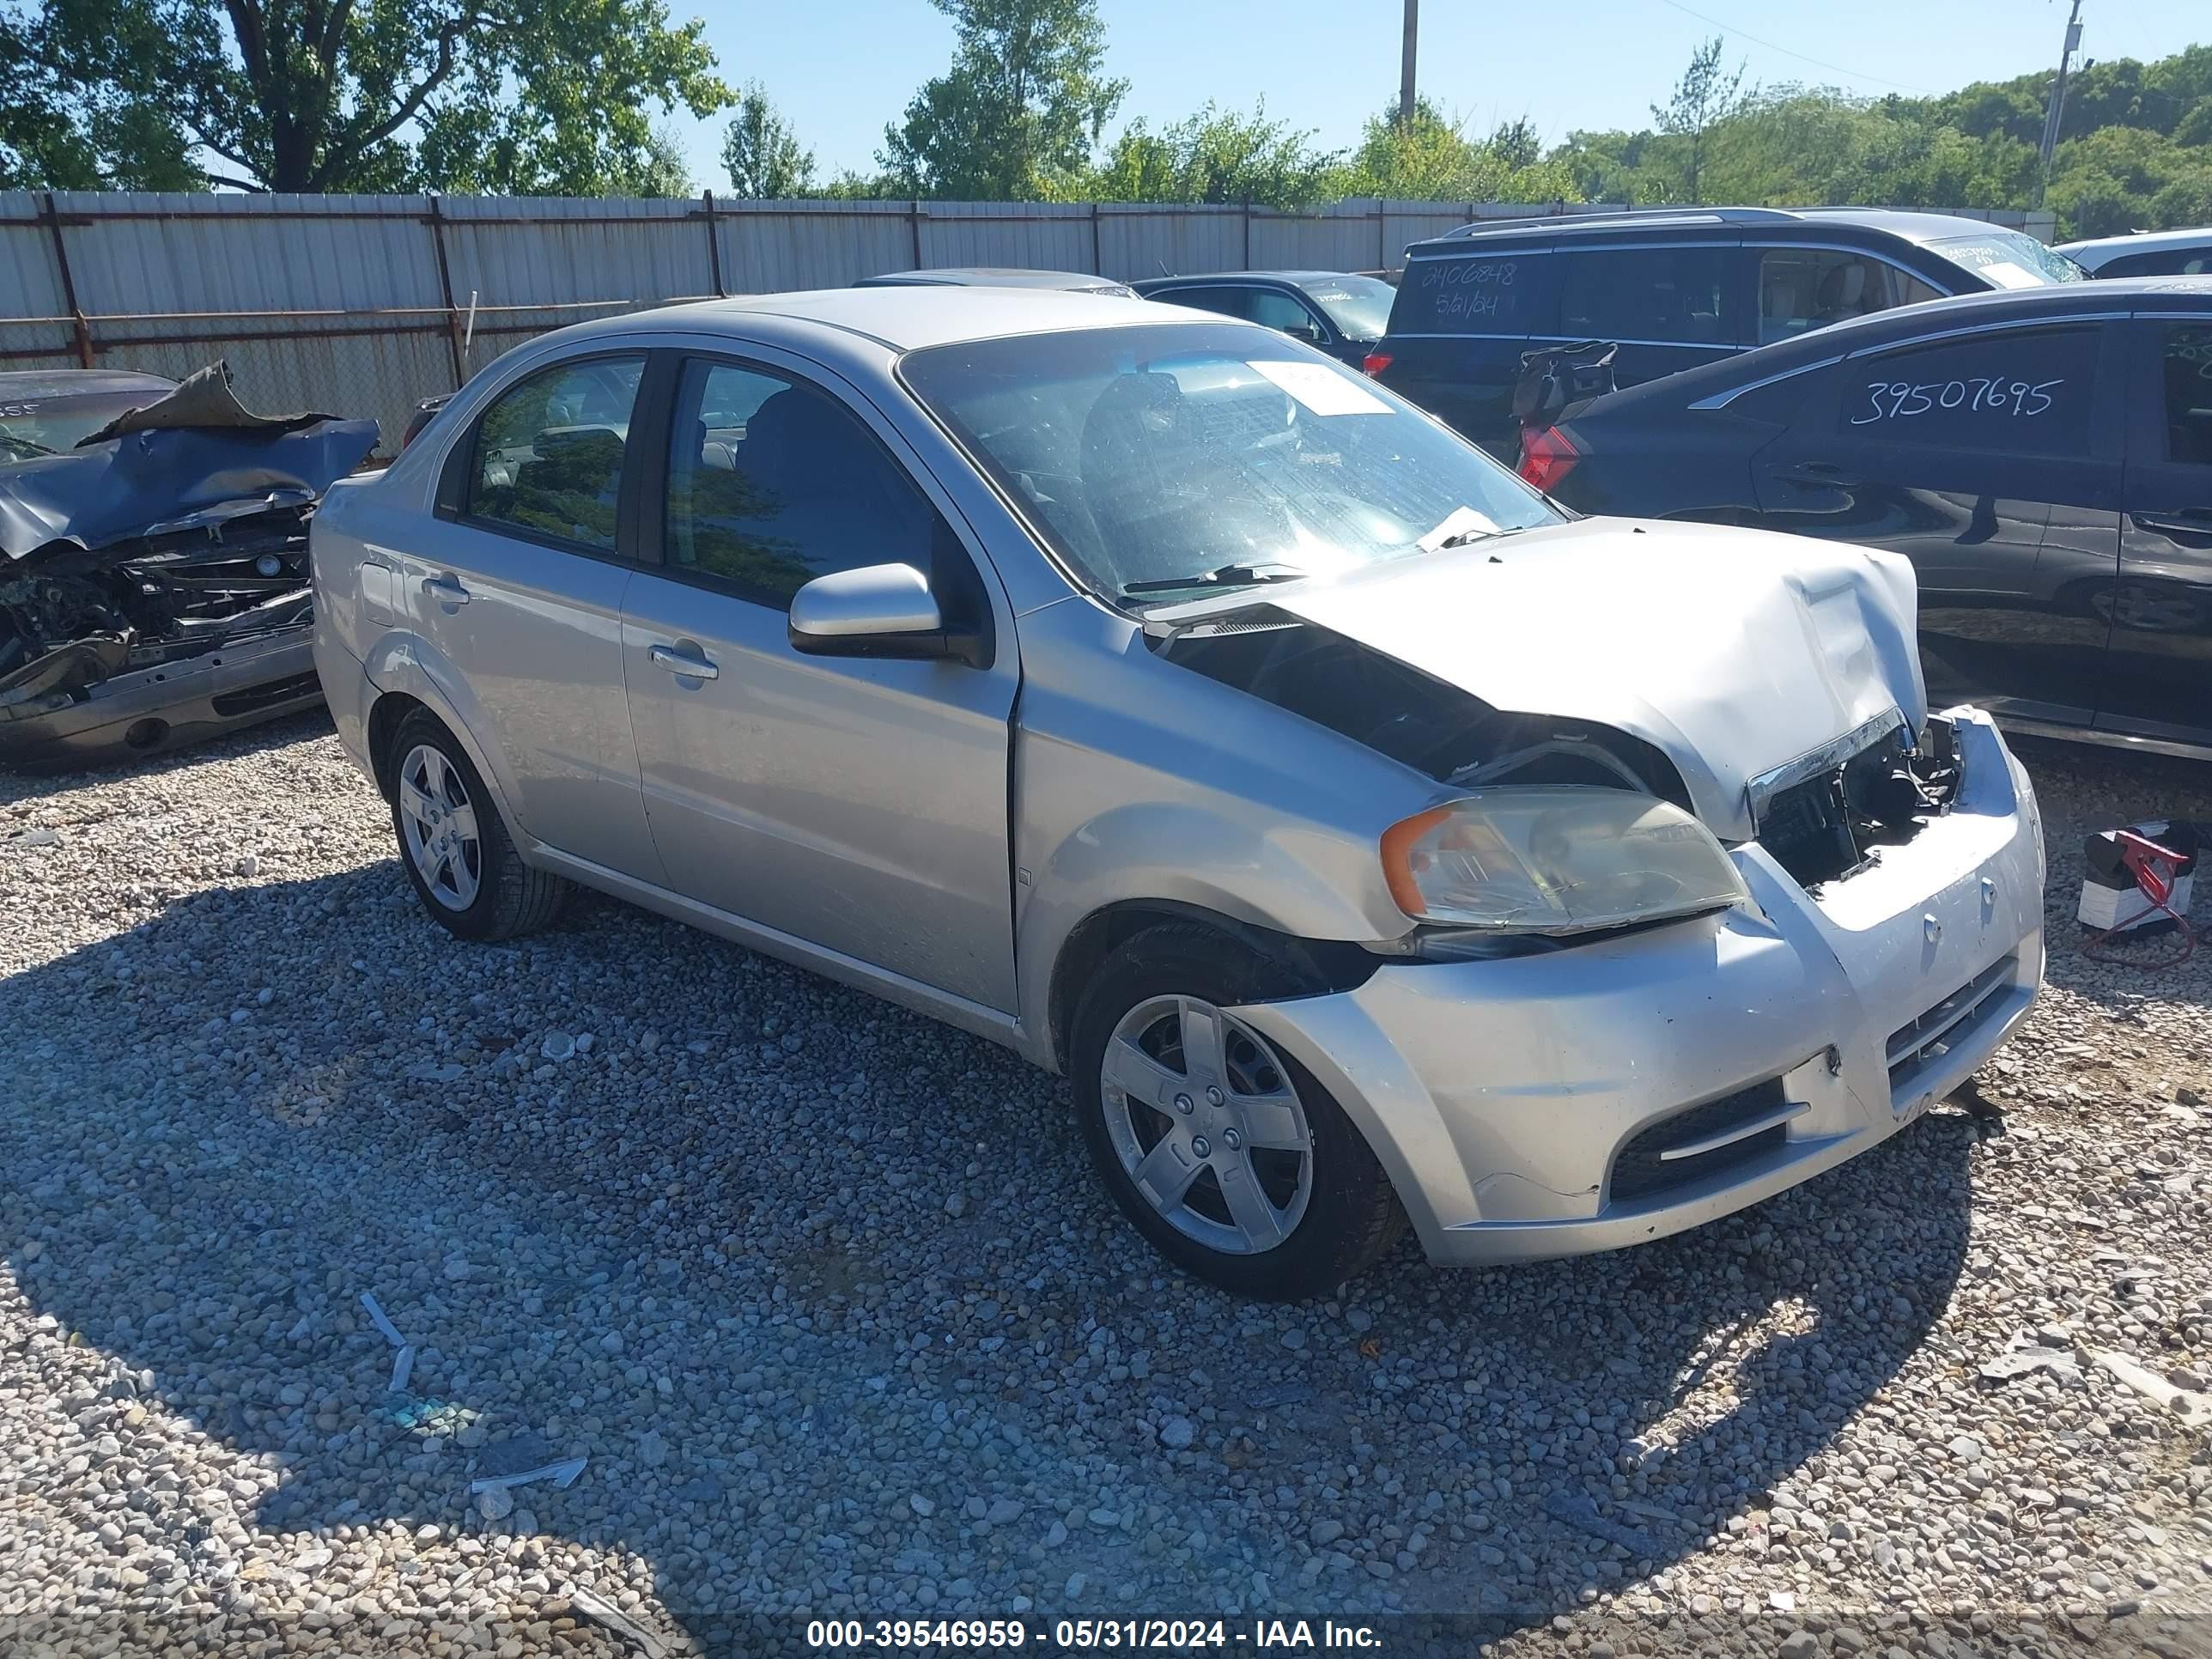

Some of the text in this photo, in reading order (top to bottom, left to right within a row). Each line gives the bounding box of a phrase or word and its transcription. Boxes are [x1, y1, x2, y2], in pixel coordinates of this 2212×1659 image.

[1422, 263, 1518, 289] 2406848
[1436, 289, 1498, 319] 5/21/24
[1850, 376, 2065, 425] 39507695
